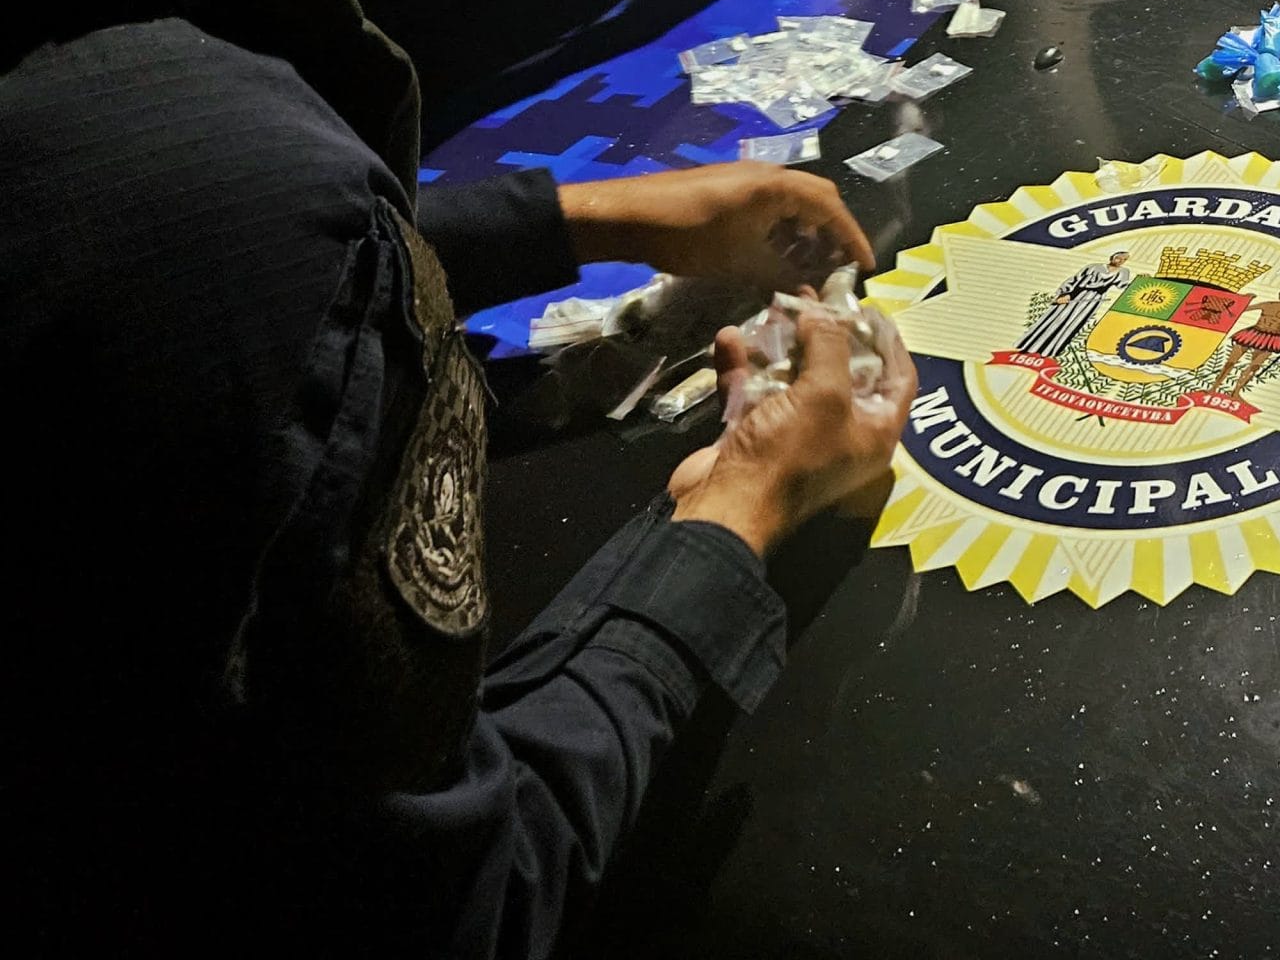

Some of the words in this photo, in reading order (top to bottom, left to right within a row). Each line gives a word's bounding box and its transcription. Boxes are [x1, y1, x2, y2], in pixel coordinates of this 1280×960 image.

[1008, 353, 1045, 367] 1560
[1201, 393, 1241, 413] 1953
[910, 386, 1280, 515] MUNICIPAL
